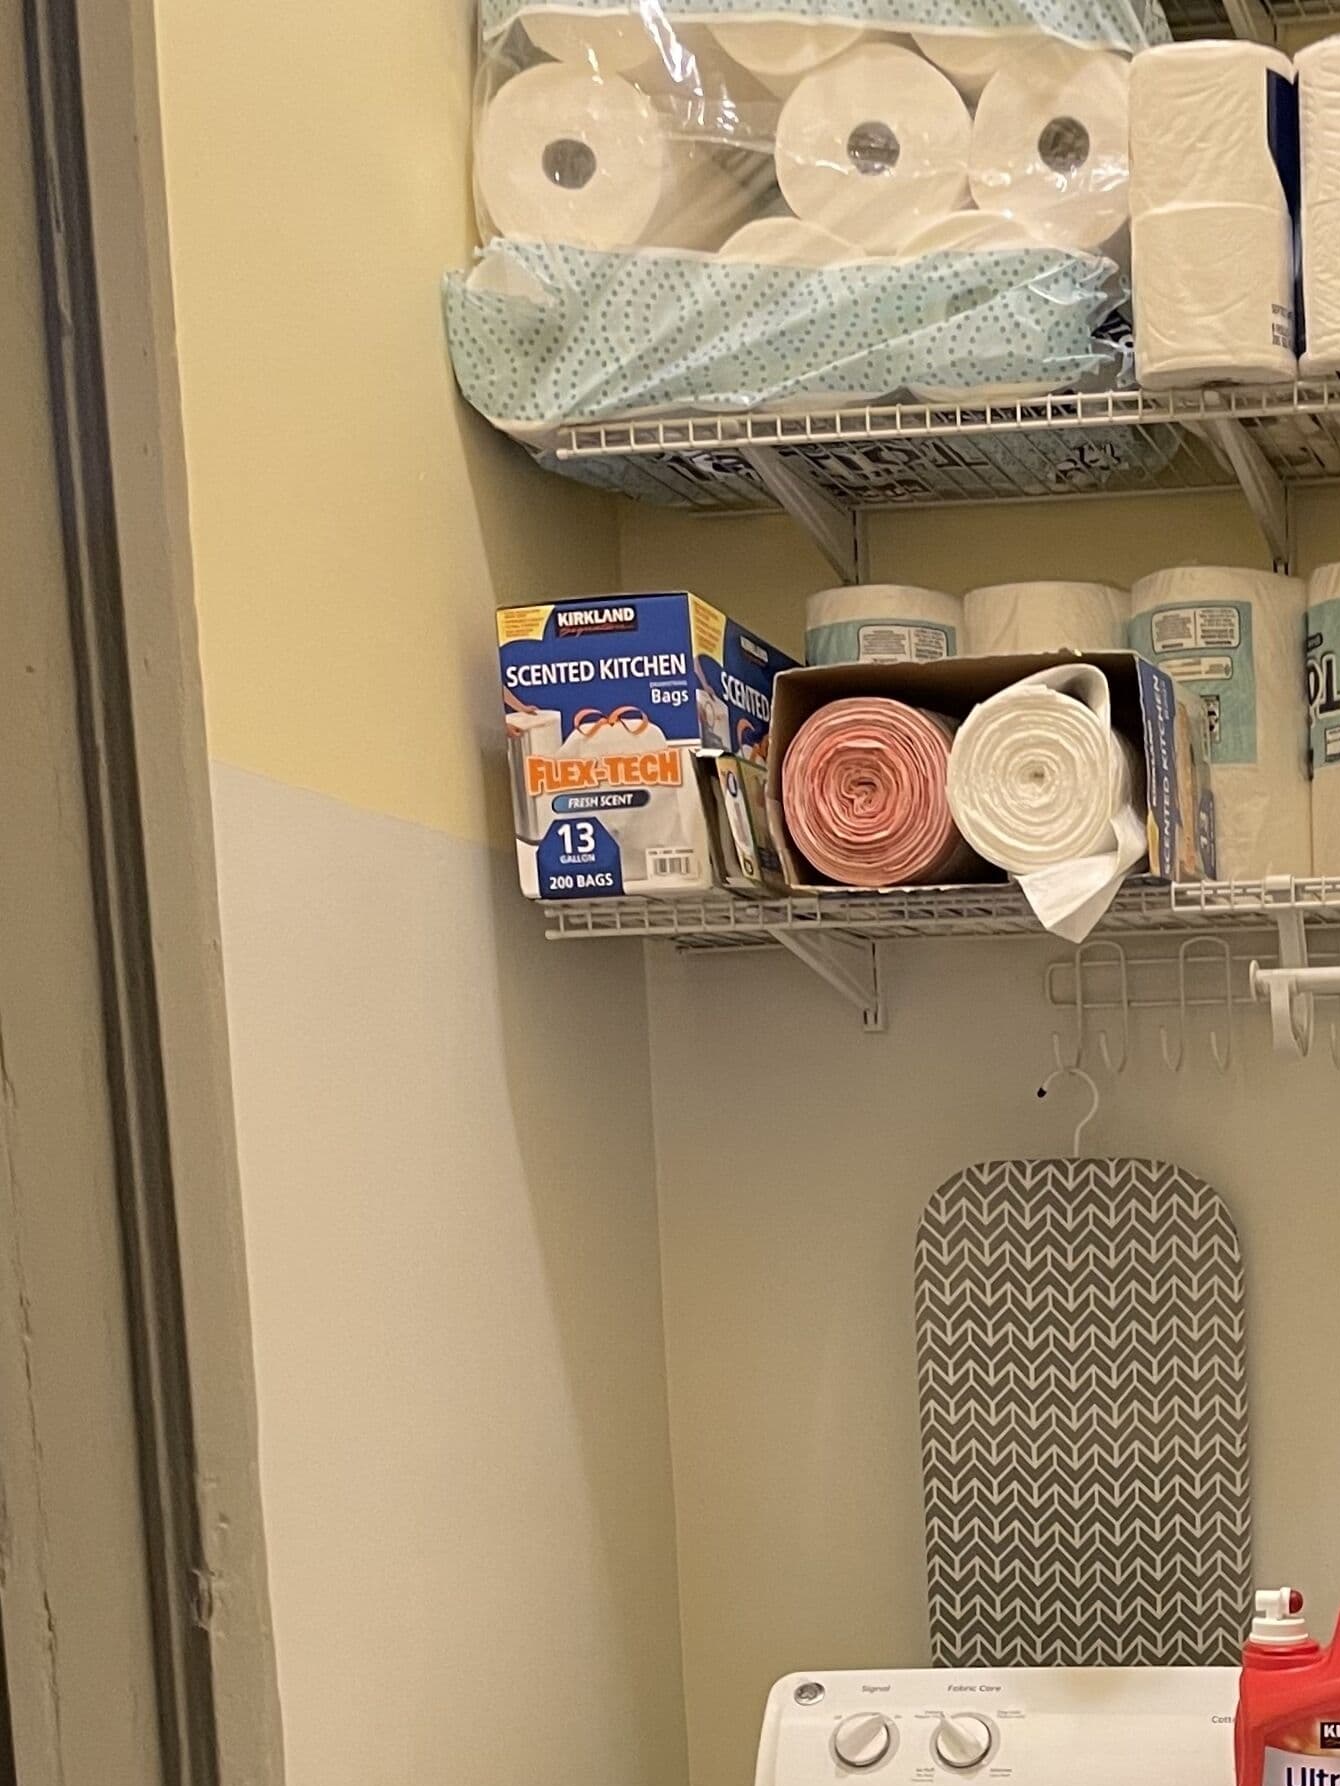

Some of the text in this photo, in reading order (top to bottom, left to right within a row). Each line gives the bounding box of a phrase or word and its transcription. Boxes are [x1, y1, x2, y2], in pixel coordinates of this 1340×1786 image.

[558, 607, 635, 628] KIRKLAND
[505, 653, 687, 688] SCENTED KITCHEN
[651, 688, 689, 706] Bags
[720, 671, 770, 723] SCENTED
[526, 751, 682, 795] FLEX-TECH
[1153, 675, 1172, 875] SCENTED KITCHEN
[568, 794, 633, 809] FRESH SCENT
[557, 822, 596, 854] 13
[559, 854, 596, 864] GALLON
[549, 873, 613, 890] 200 BAGS
[862, 1685, 891, 1693] Signal
